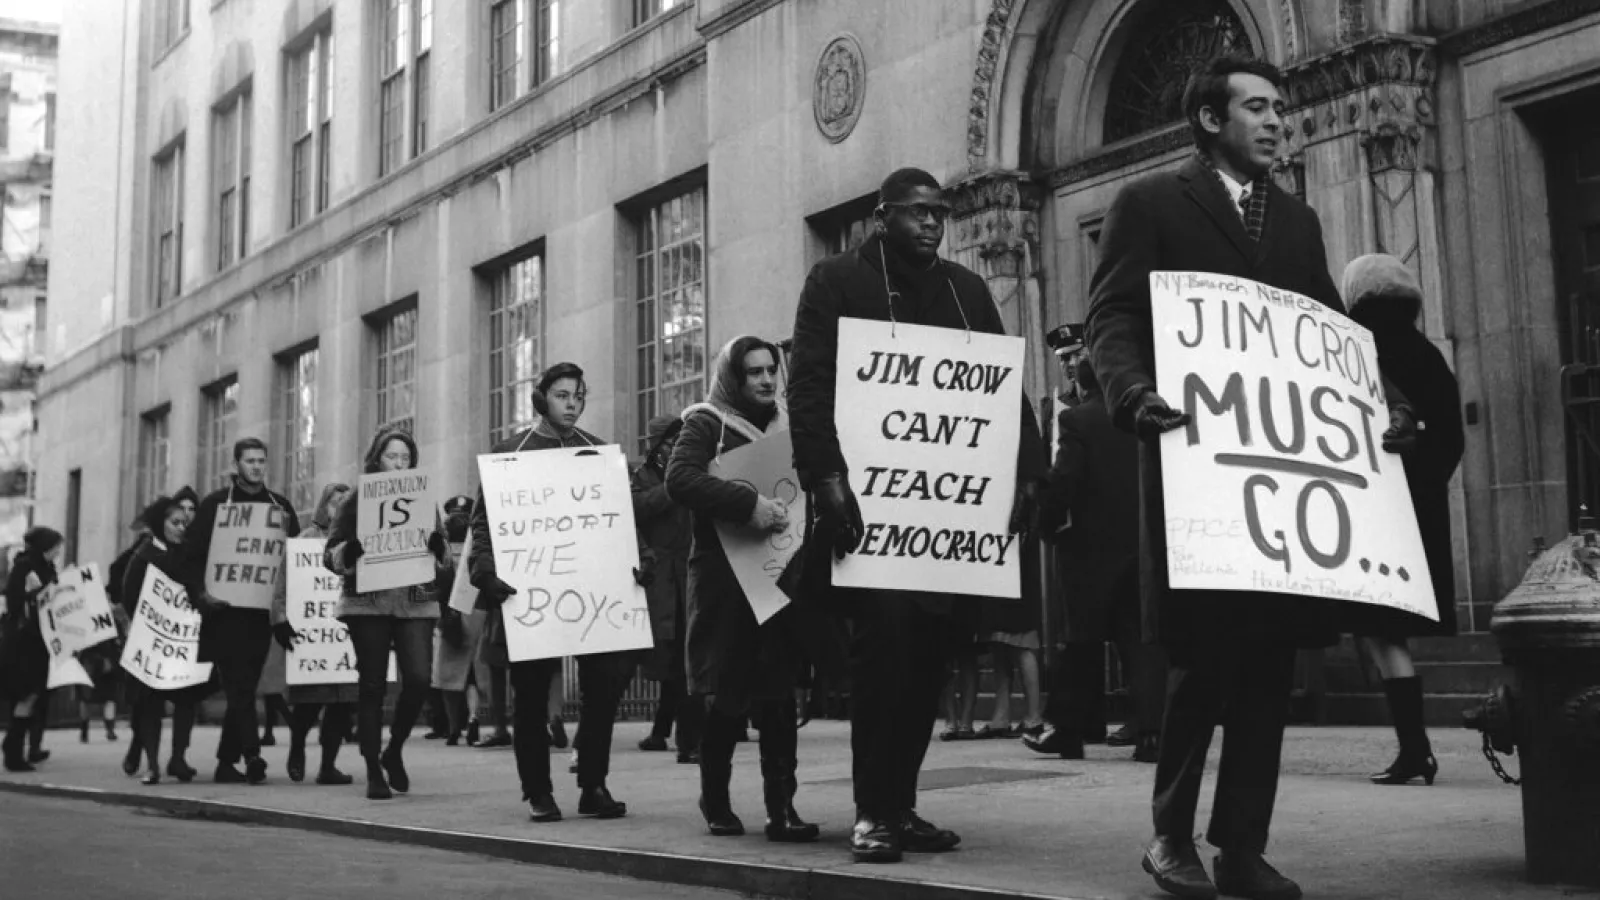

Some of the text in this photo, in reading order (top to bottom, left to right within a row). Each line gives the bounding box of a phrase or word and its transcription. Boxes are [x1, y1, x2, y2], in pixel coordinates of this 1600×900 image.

[1177, 298, 1279, 358] JIM
[1294, 313, 1386, 405] CROW
[857, 351, 1013, 395] JIM CROW
[881, 410, 991, 448] CAN'T
[1183, 372, 1381, 475] MUST
[501, 483, 602, 508] HELP US
[861, 466, 992, 506] TEACH
[218, 504, 253, 529] JIM
[379, 497, 417, 531] IS
[497, 512, 621, 537] SUPPORT
[295, 552, 325, 568] INT
[501, 541, 577, 577] THE
[850, 523, 1015, 566] EMOCRACY
[152, 638, 189, 662] FOR
[294, 627, 350, 645] SCHO
[298, 658, 328, 672] FOR
